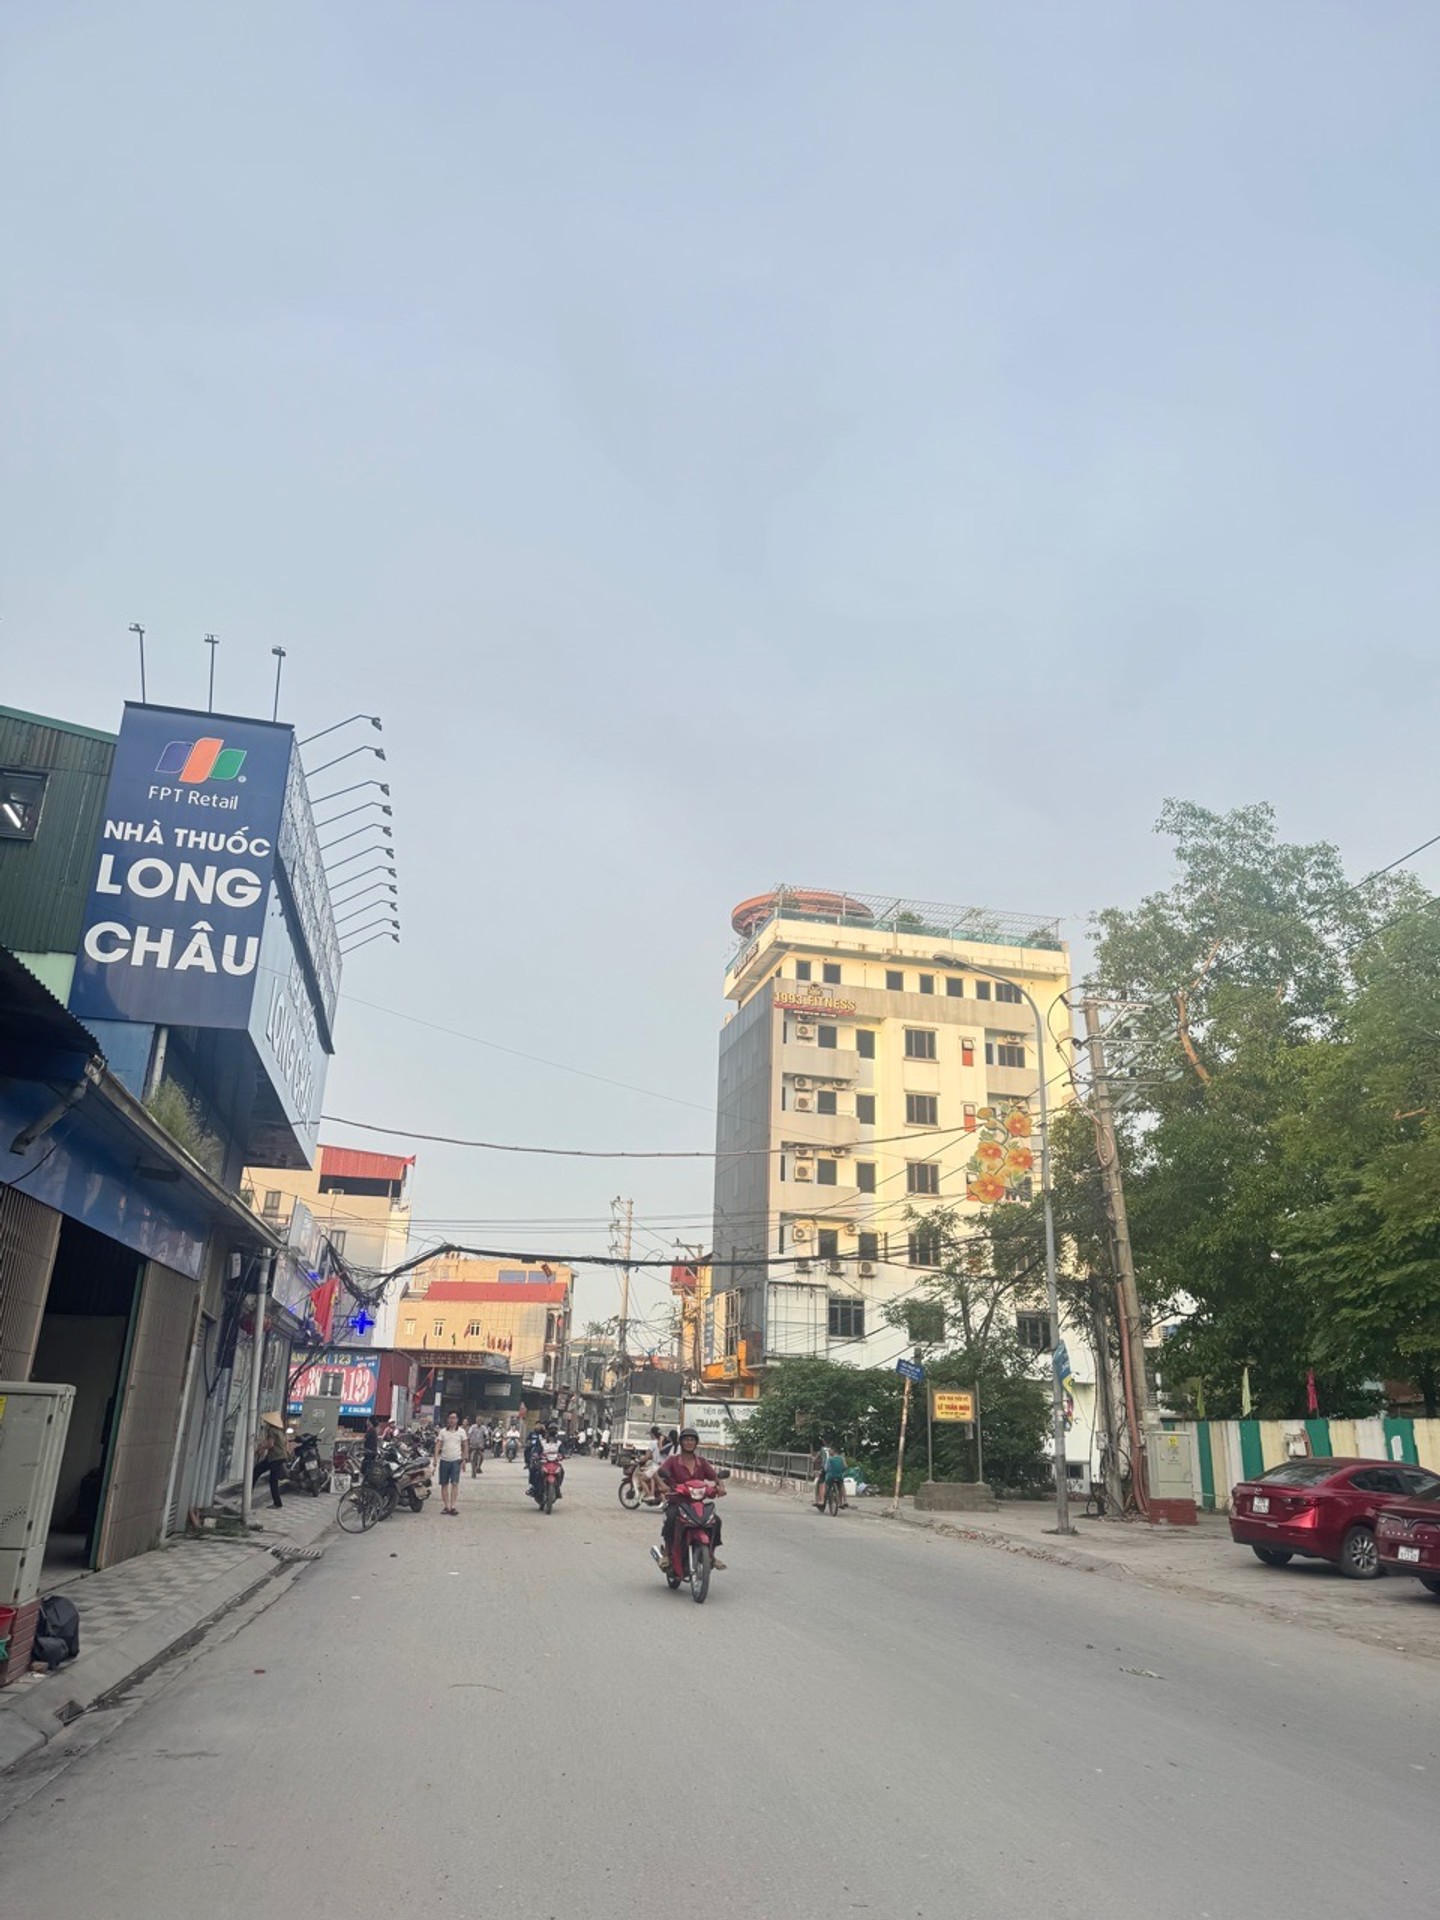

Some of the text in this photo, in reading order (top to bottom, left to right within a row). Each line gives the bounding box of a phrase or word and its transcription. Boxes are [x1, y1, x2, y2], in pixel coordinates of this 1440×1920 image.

[148, 786, 239, 810] FPT Retail
[103, 819, 271, 857] NHÀ THUỐC
[96, 853, 262, 908] LONG
[83, 920, 259, 976] CHÂU
